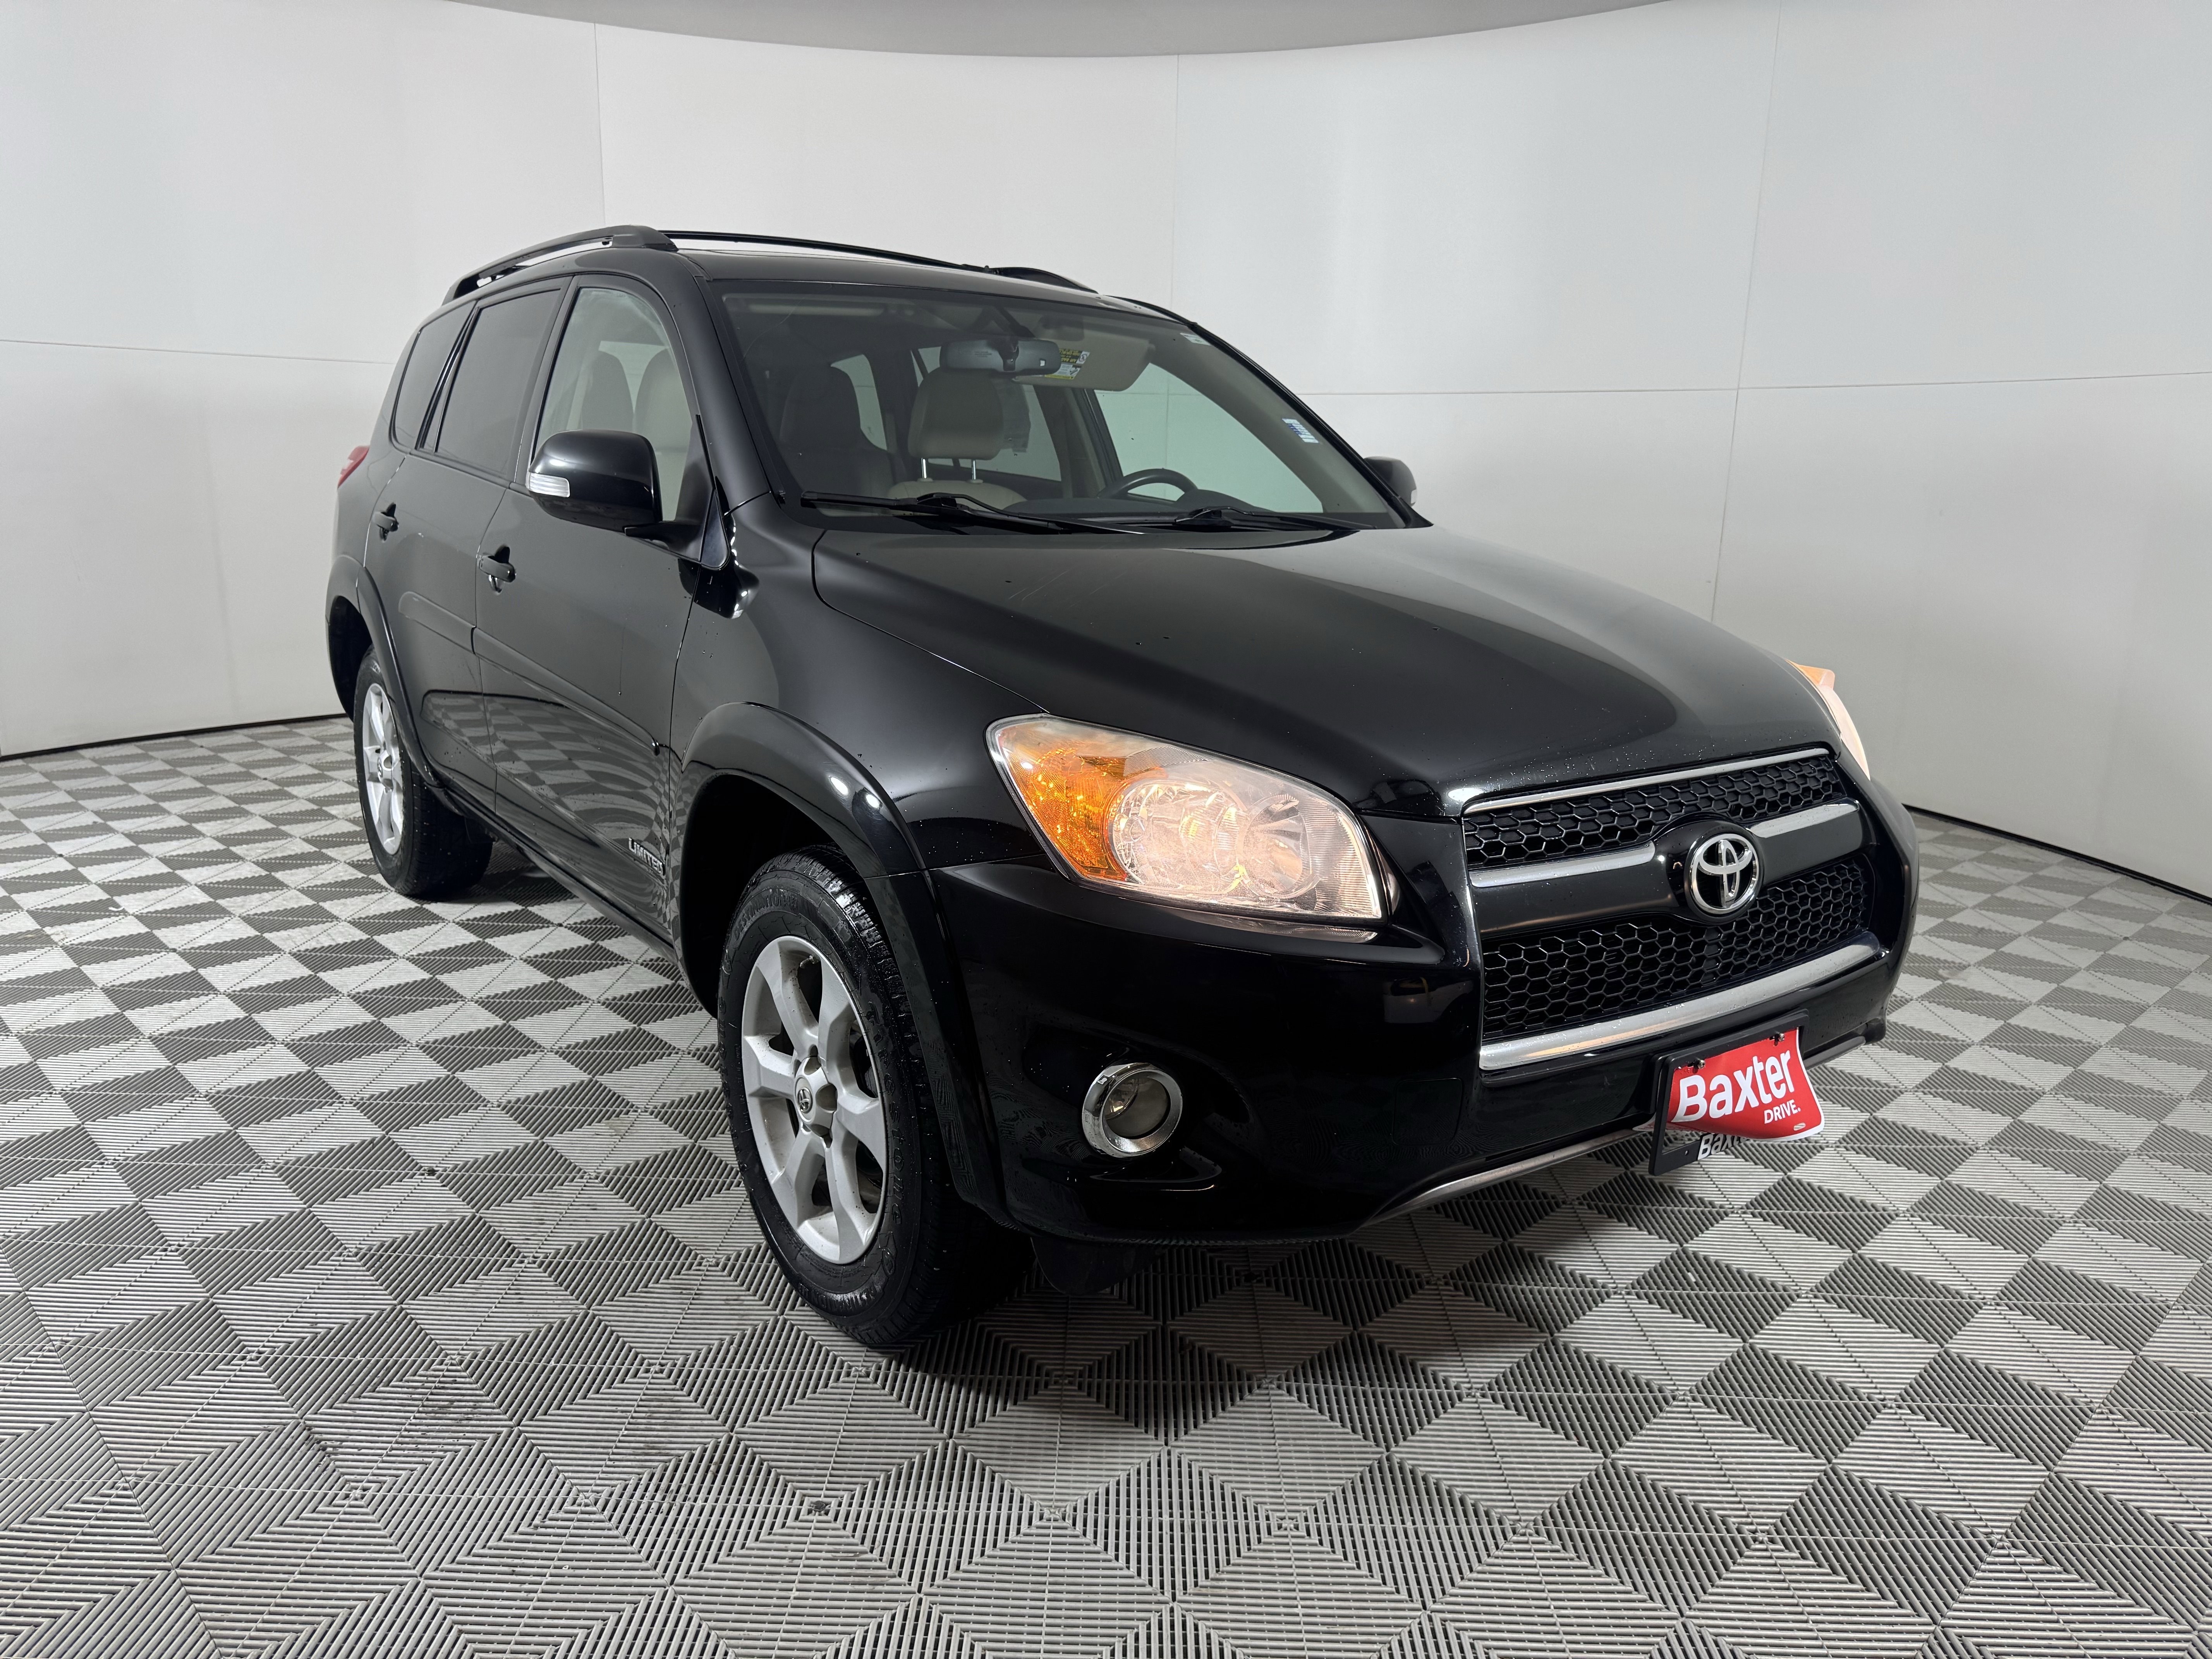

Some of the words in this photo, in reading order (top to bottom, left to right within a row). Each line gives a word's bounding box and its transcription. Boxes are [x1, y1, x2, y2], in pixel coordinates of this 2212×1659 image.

[1671, 1050, 1795, 1123] Baxter
[1764, 1099, 1801, 1124] DRIVE.
[865, 1001, 905, 1224] Firestone
[1697, 1133, 1747, 1160] Baxt
